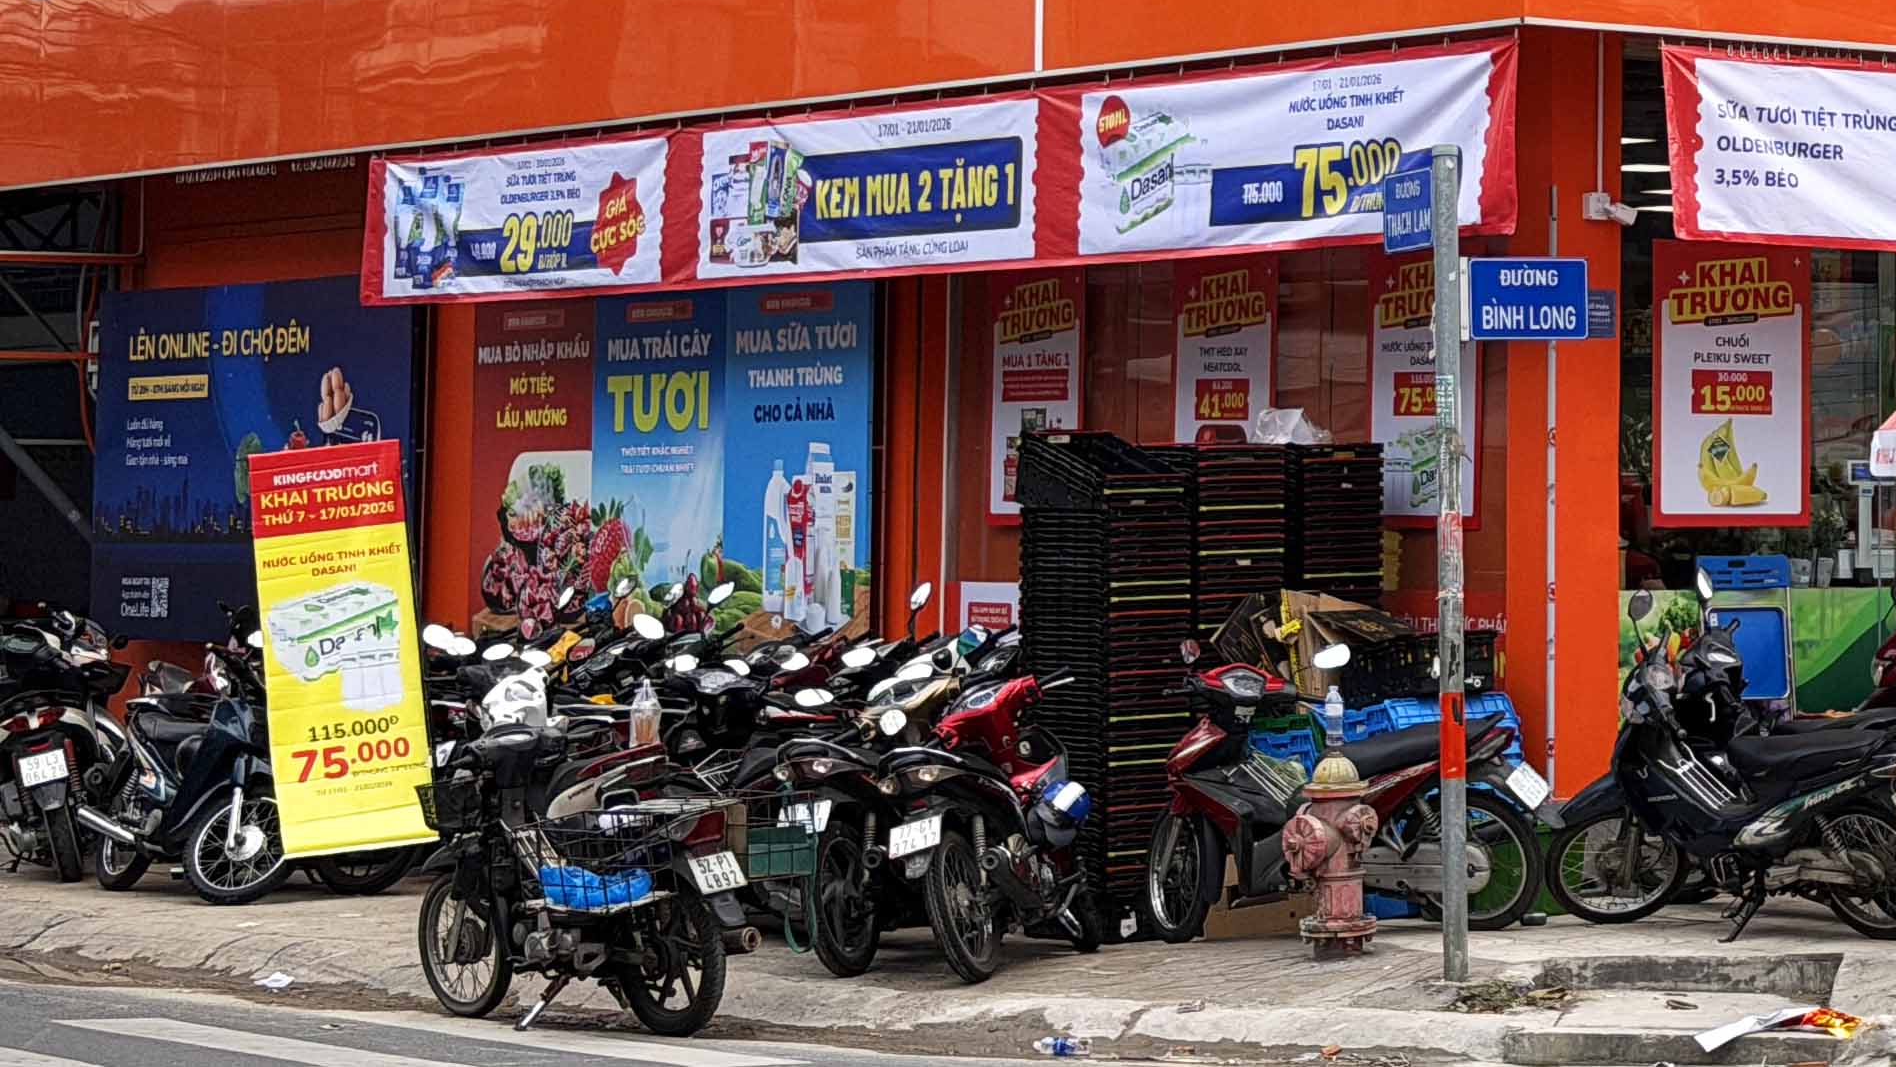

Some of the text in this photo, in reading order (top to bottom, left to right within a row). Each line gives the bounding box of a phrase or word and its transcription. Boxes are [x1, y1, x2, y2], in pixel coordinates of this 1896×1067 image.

[1289, 86, 1404, 113] NƯỚC UỐNG TINH KHIẾT
[1327, 116, 1364, 131] DASANI
[1718, 100, 1749, 120] SỮA
[1756, 106, 1797, 123] TƯƠI
[1802, 106, 1837, 132] TIỆT
[878, 123, 899, 137] 17/01
[1717, 135, 1844, 160] OLDENBURGER
[816, 157, 1015, 223] KEM MUA 2 TẶNG 1
[1714, 166, 1799, 188] 3,5% BÉO
[500, 212, 573, 273] 29.000
[590, 213, 645, 258] CỰC SỐC
[1203, 272, 1247, 300] KHAI
[1500, 264, 1559, 286] ĐƯỜNG
[1700, 260, 1764, 287] KHAI
[1016, 281, 1059, 307] KHAI
[1672, 285, 1791, 316] TRƯƠNG
[1002, 302, 1073, 337] TRƯƠNG
[1185, 294, 1264, 329] TRƯƠNG
[1482, 297, 1524, 330] BÌNH
[1530, 306, 1576, 330] LONG
[129, 318, 310, 361] LÊN ONLINE ĐI CHỢ ĐÊM
[478, 333, 589, 366] MUA BÒ NHẬP KHẨU
[608, 330, 677, 362] MUA TRÁI
[736, 321, 857, 355] MUA SỮA TƯƠI
[1716, 332, 1750, 348] CHUỐI
[1002, 355, 1024, 369] MUA
[1694, 352, 1771, 364] PLEIKU SWEET
[530, 372, 555, 400] TIỆC
[748, 368, 794, 389] THANH
[607, 370, 710, 433] TƯƠI
[754, 396, 835, 423] CHO CẢ NHÀ
[1200, 392, 1244, 418] 41.000
[1700, 384, 1765, 412] 15.000
[273, 462, 379, 486] KINGFOODmart
[260, 480, 394, 510] KHAI TRƯƠNG
[262, 501, 394, 526] THỨ 7 17/01/2026
[300, 548, 365, 566] UỐNG TINH
[312, 564, 357, 578] DASANI
[291, 736, 410, 783] 75.000
[696, 853, 732, 875] 52-P1
